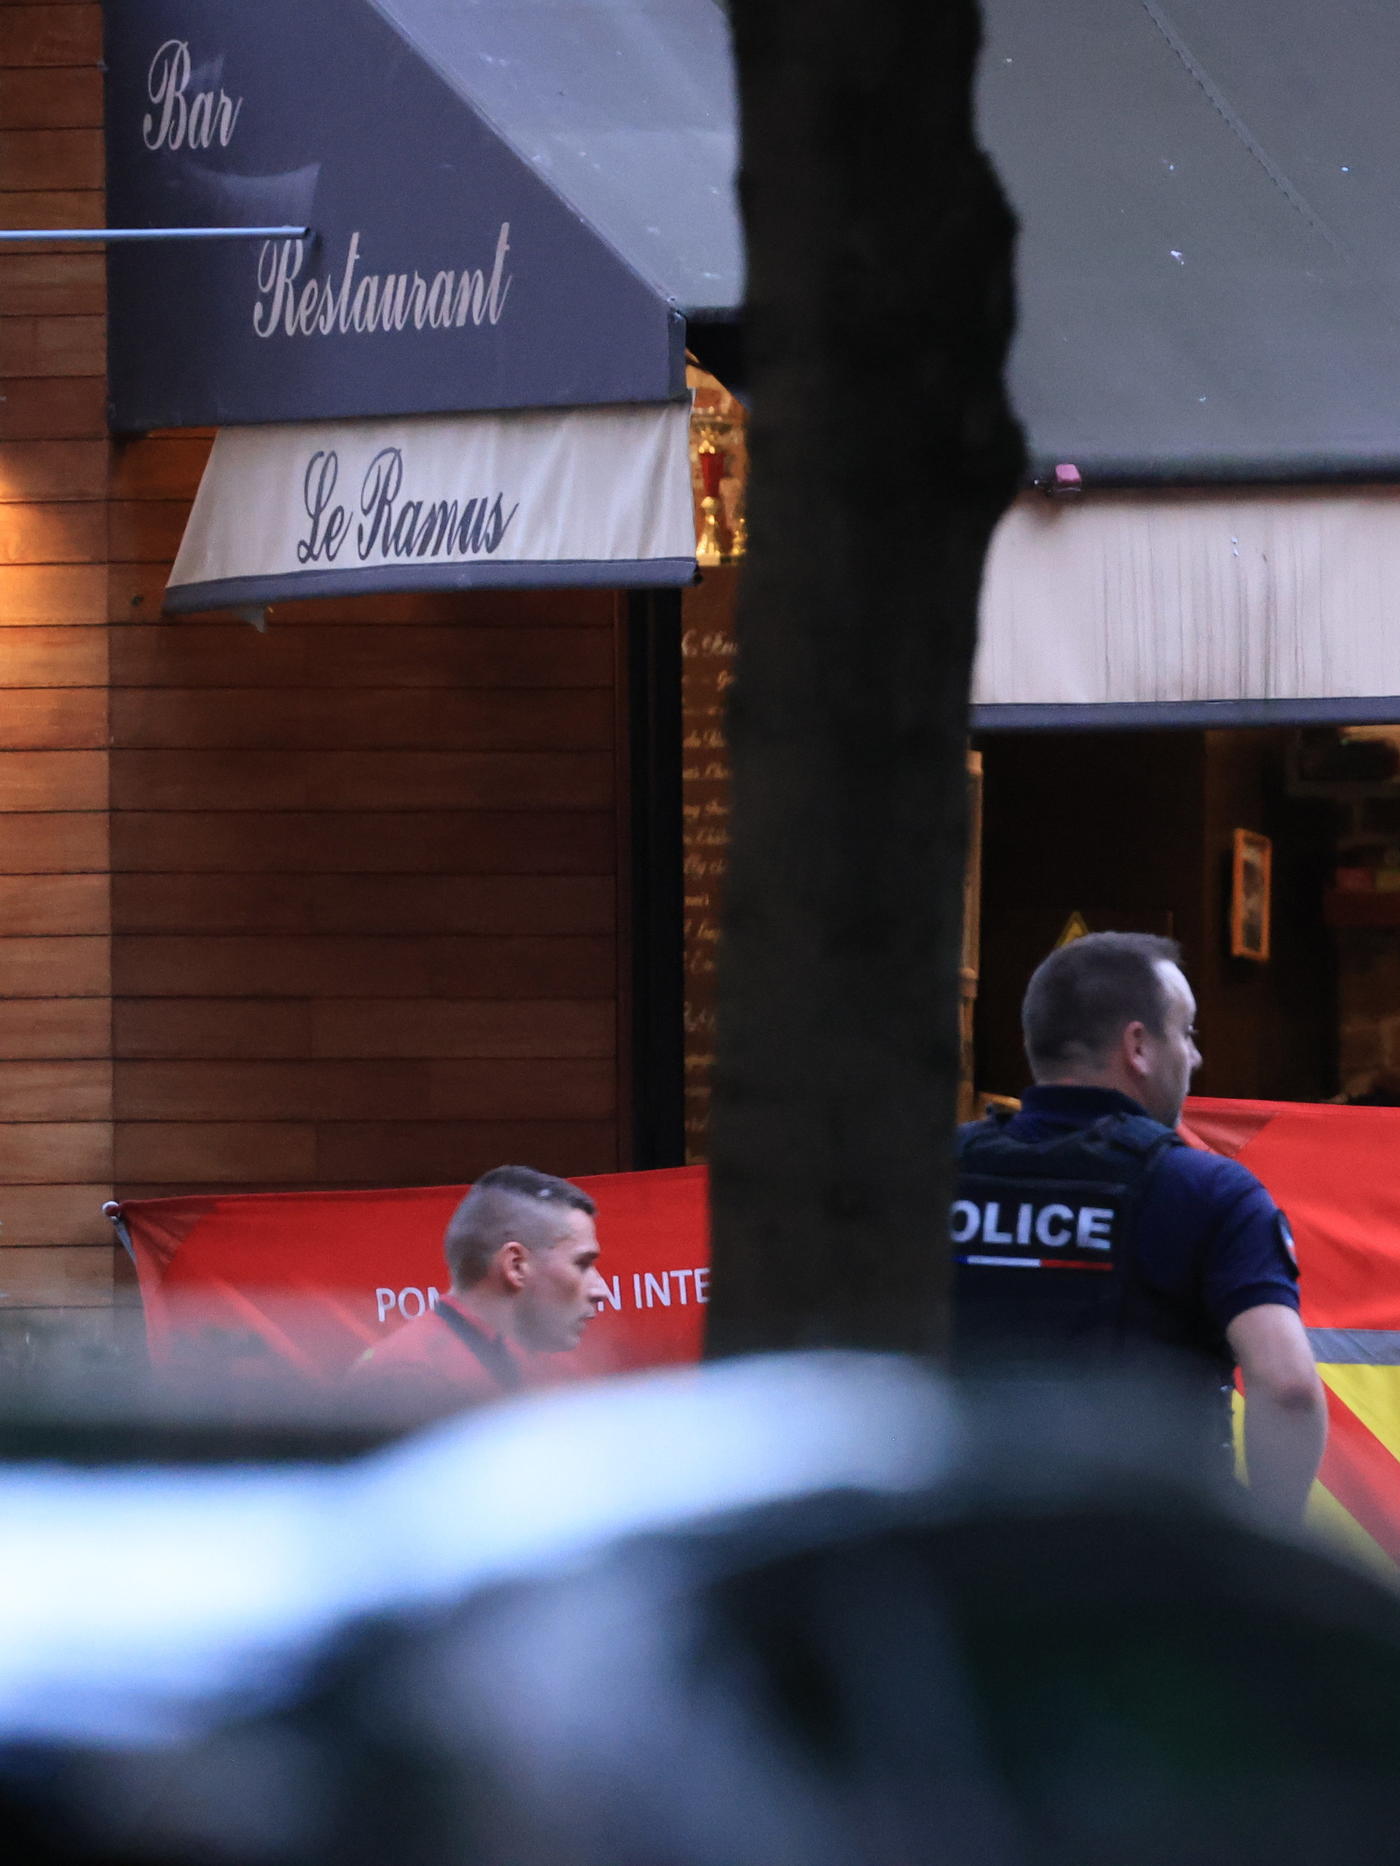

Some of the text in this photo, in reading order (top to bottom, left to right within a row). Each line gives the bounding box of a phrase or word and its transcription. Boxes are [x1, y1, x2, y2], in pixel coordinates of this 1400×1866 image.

[143, 39, 243, 151] Bar
[254, 222, 511, 339] Restaurant
[297, 447, 519, 563] Le Ramus
[950, 1200, 1115, 1250] OLICE
[596, 1275, 622, 1312] N
[633, 1267, 711, 1309] INTE
